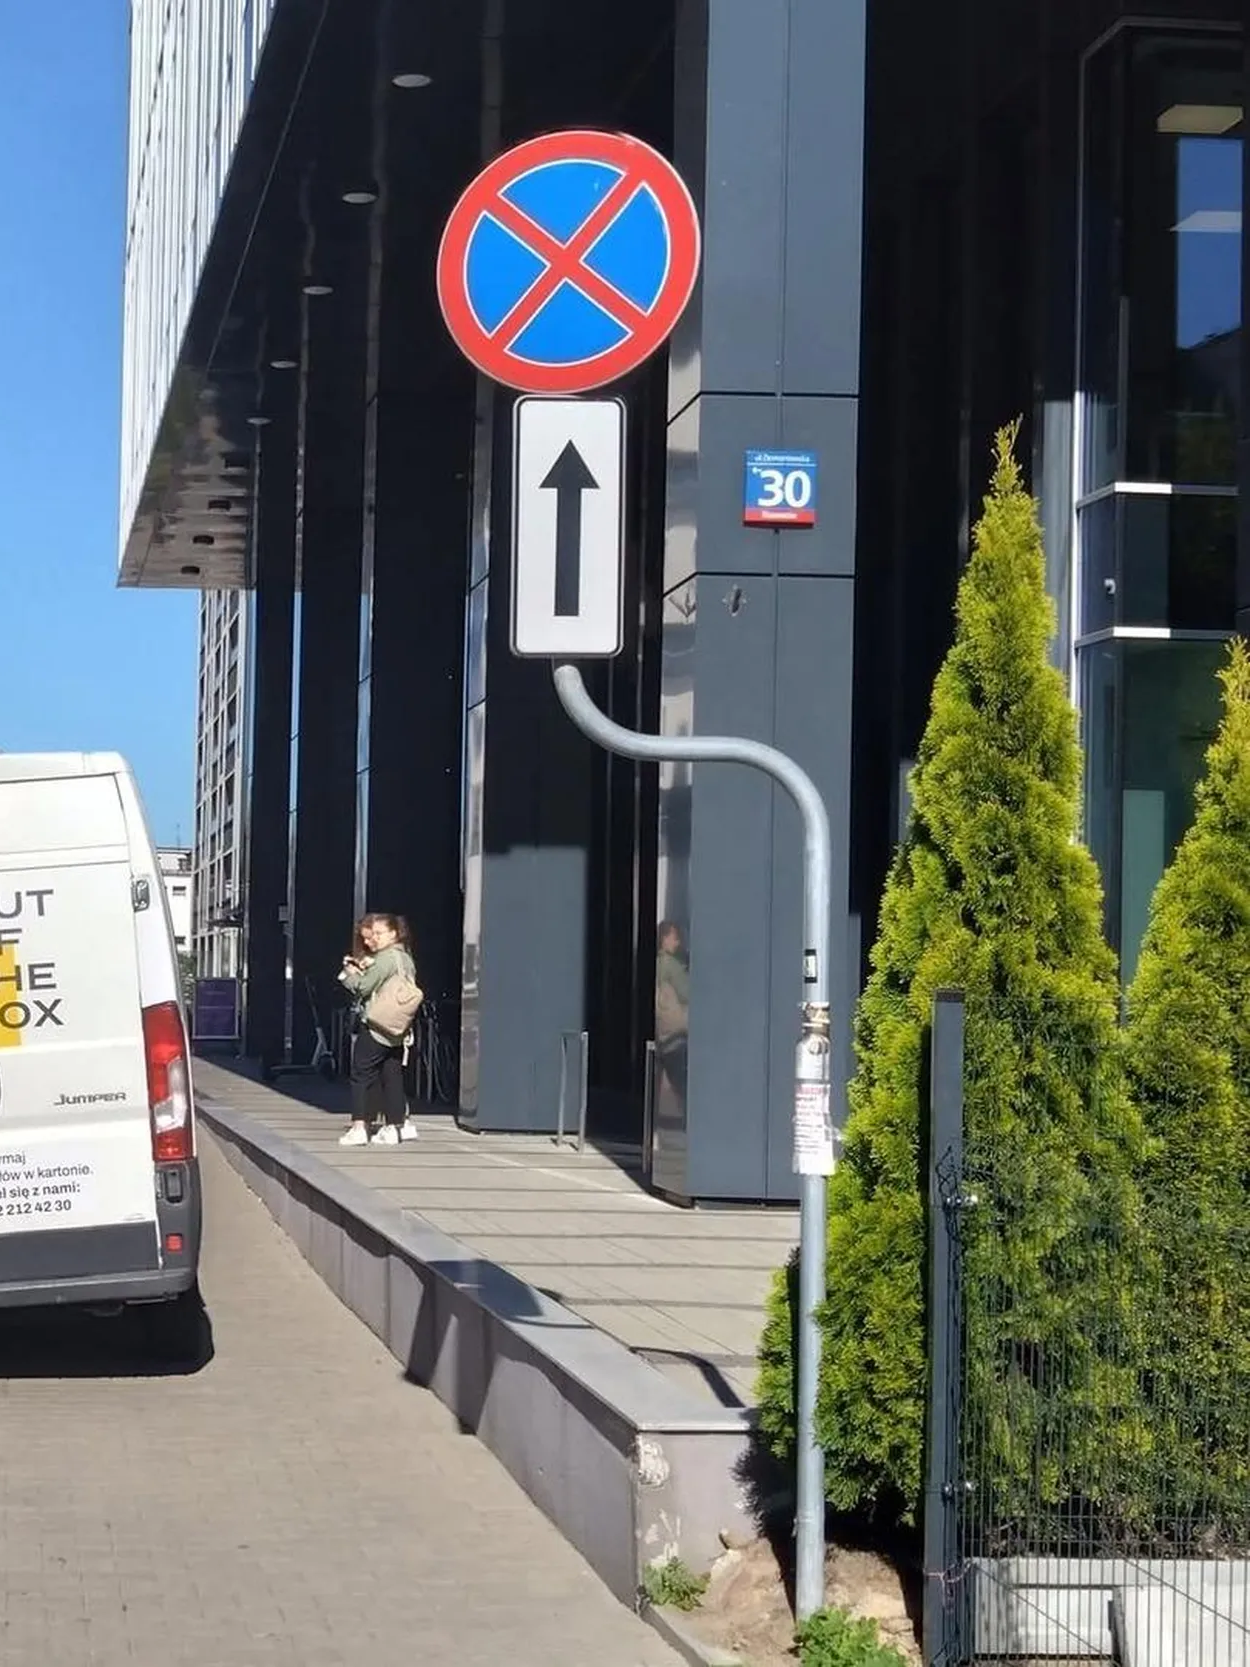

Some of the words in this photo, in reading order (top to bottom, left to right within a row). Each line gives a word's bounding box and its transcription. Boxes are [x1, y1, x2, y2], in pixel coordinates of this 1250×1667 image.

[758, 469, 811, 508] 30
[23, 1171, 35, 1180] w
[38, 1164, 93, 1179] kartonie.
[9, 1186, 29, 1199] się
[32, 1187, 40, 1197] z
[43, 1181, 81, 1195] nami:
[6, 1203, 32, 1216] 212
[35, 1201, 52, 1213] 42
[55, 1199, 72, 1211] 30
